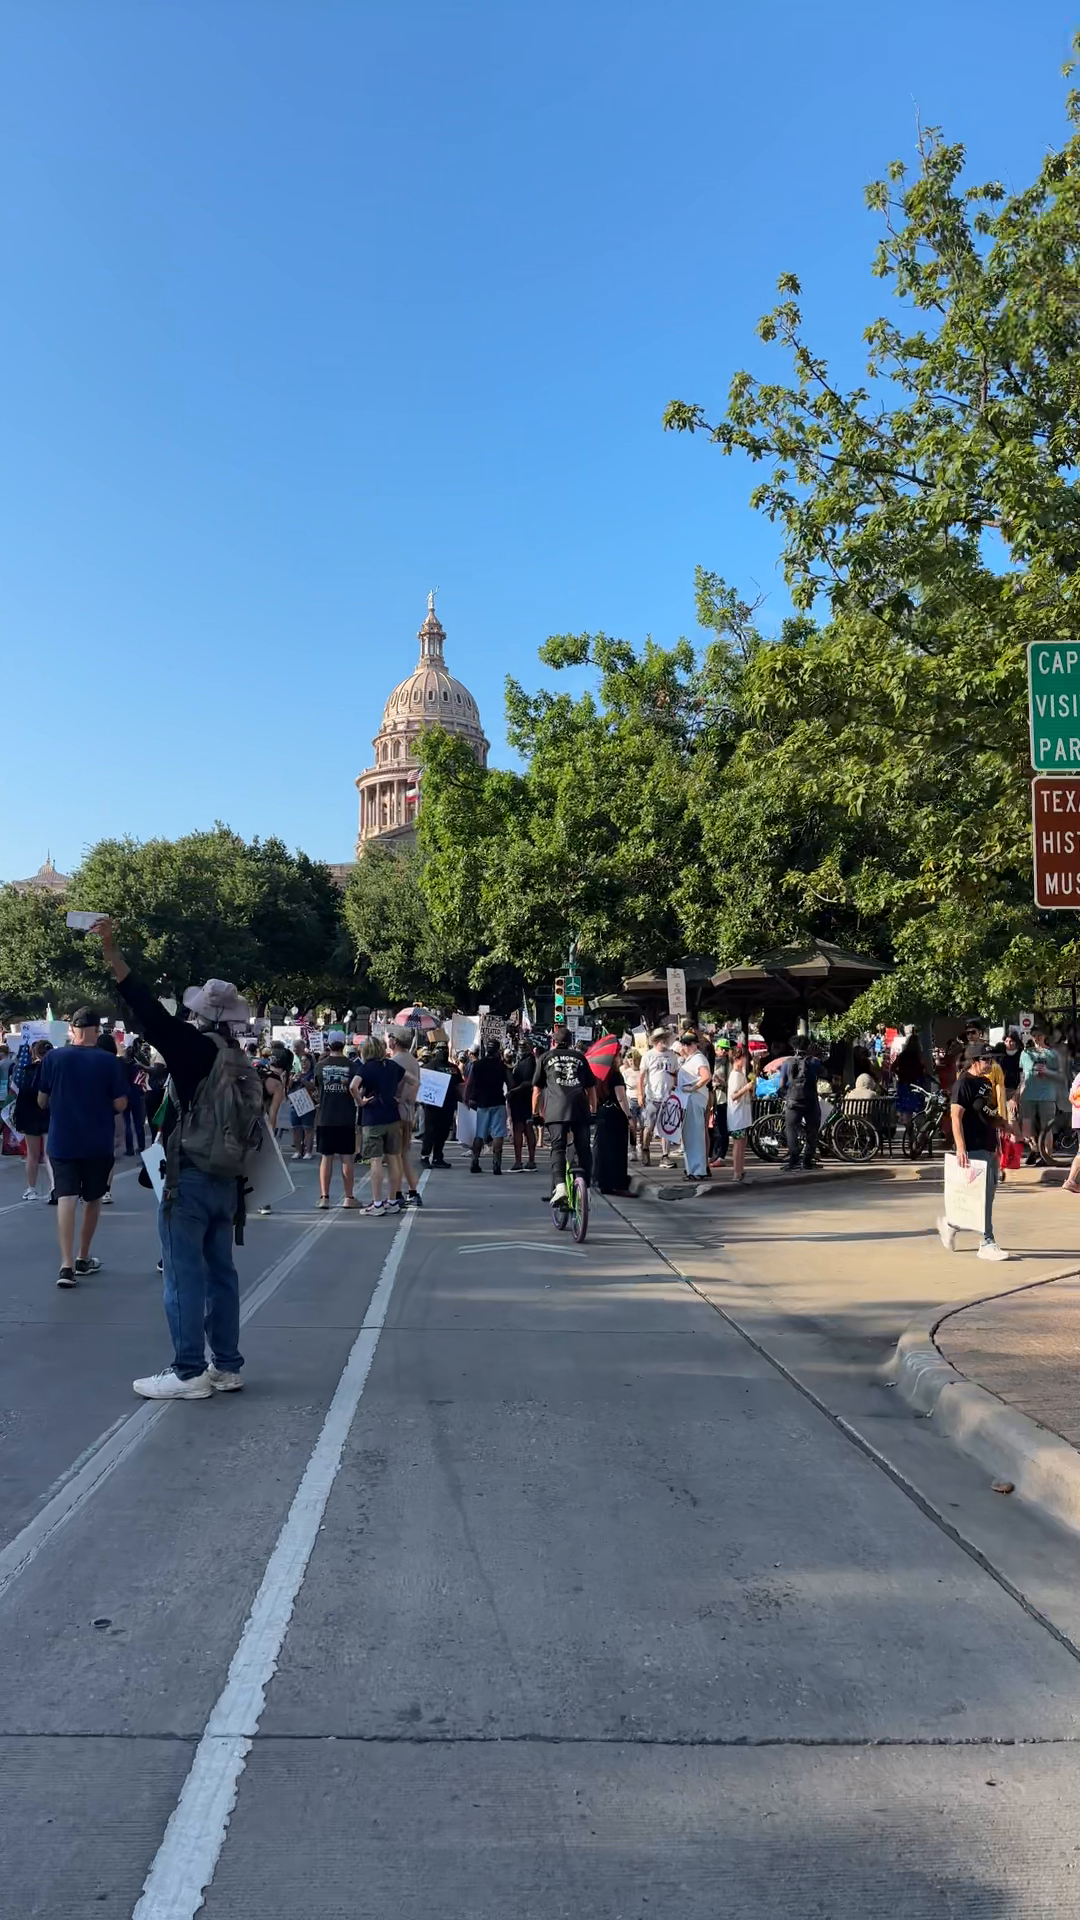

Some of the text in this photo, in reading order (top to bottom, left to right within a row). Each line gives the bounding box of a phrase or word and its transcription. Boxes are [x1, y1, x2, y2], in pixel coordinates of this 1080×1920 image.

[1038, 650, 1078, 675] CAP
[1039, 737, 1080, 761] PAR
[1040, 790, 1080, 813] TEX
[548, 1056, 559, 1066] GAS
[555, 1077, 580, 1086] GARAGE
